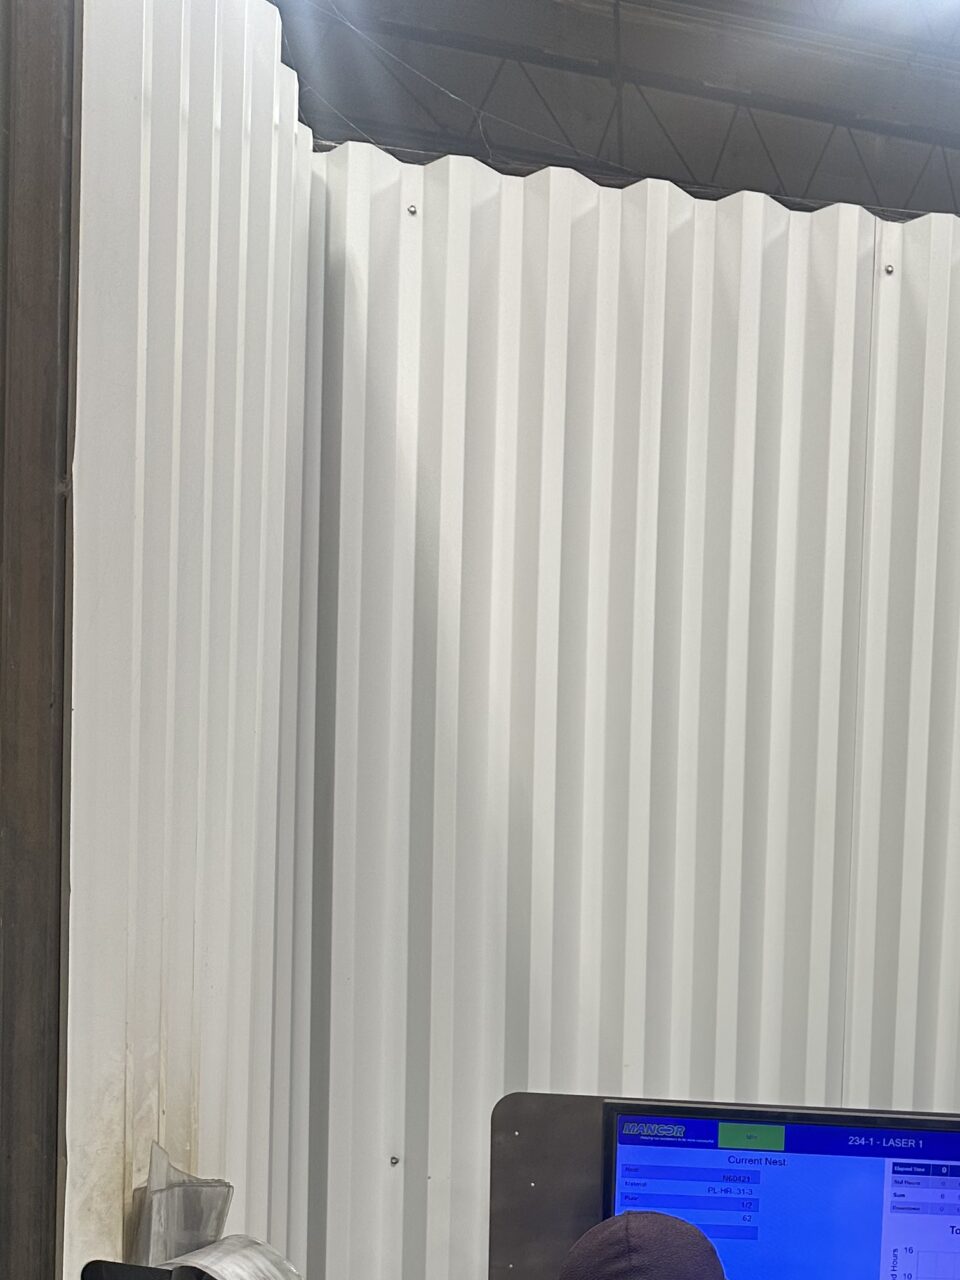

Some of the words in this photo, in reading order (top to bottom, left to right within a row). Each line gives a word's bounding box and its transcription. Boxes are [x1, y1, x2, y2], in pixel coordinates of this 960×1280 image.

[623, 1122, 685, 1136] MANCOR
[848, 1137, 873, 1146] 234-1
[883, 1138, 915, 1148] LASER
[728, 1155, 762, 1166] Current
[742, 1201, 752, 1209] 1/2
[742, 1214, 752, 1222] 62
[904, 1246, 913, 1254] 16
[890, 1248, 898, 1271] Hours
